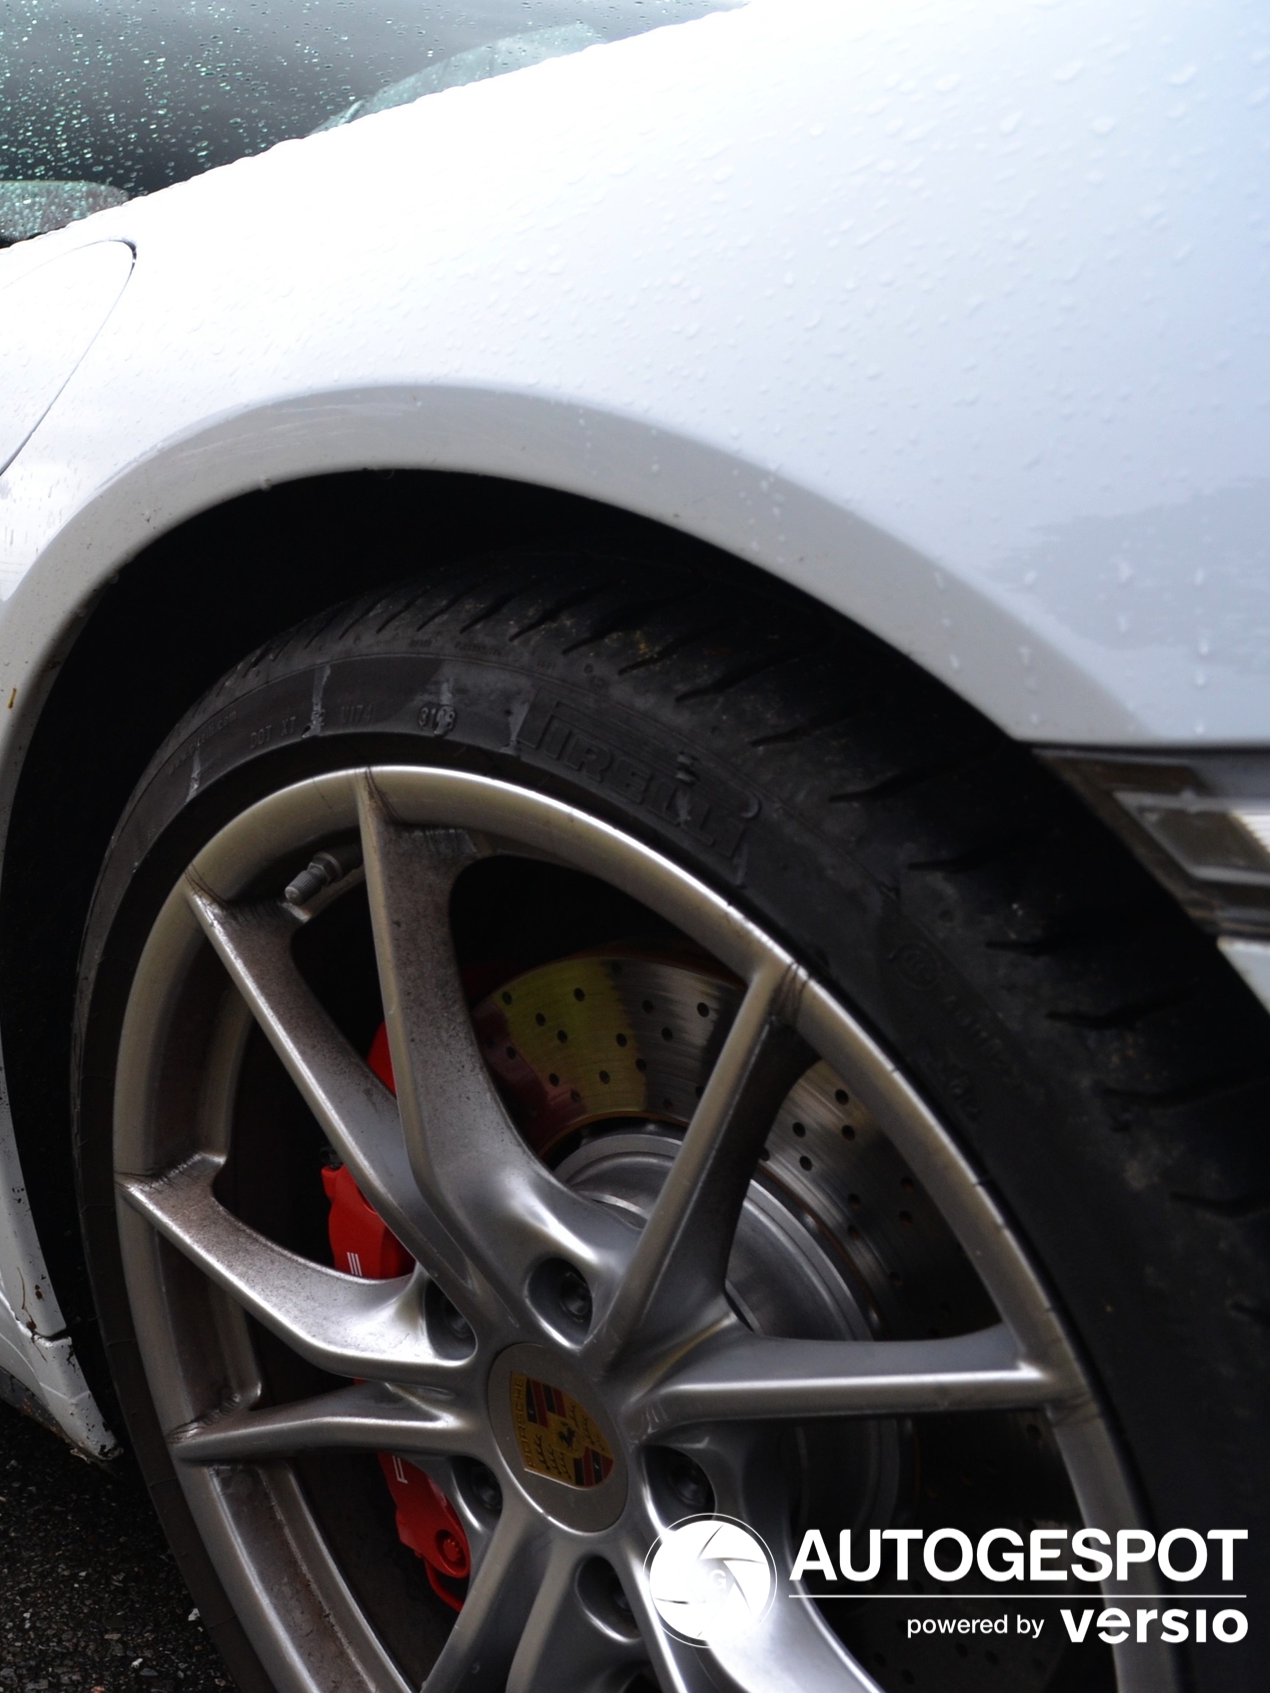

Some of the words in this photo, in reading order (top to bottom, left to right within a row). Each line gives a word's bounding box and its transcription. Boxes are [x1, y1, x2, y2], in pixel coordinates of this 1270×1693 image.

[249, 724, 273, 750] DOT
[516, 686, 762, 859] PIRELLI
[513, 1377, 537, 1469] PORSCHE
